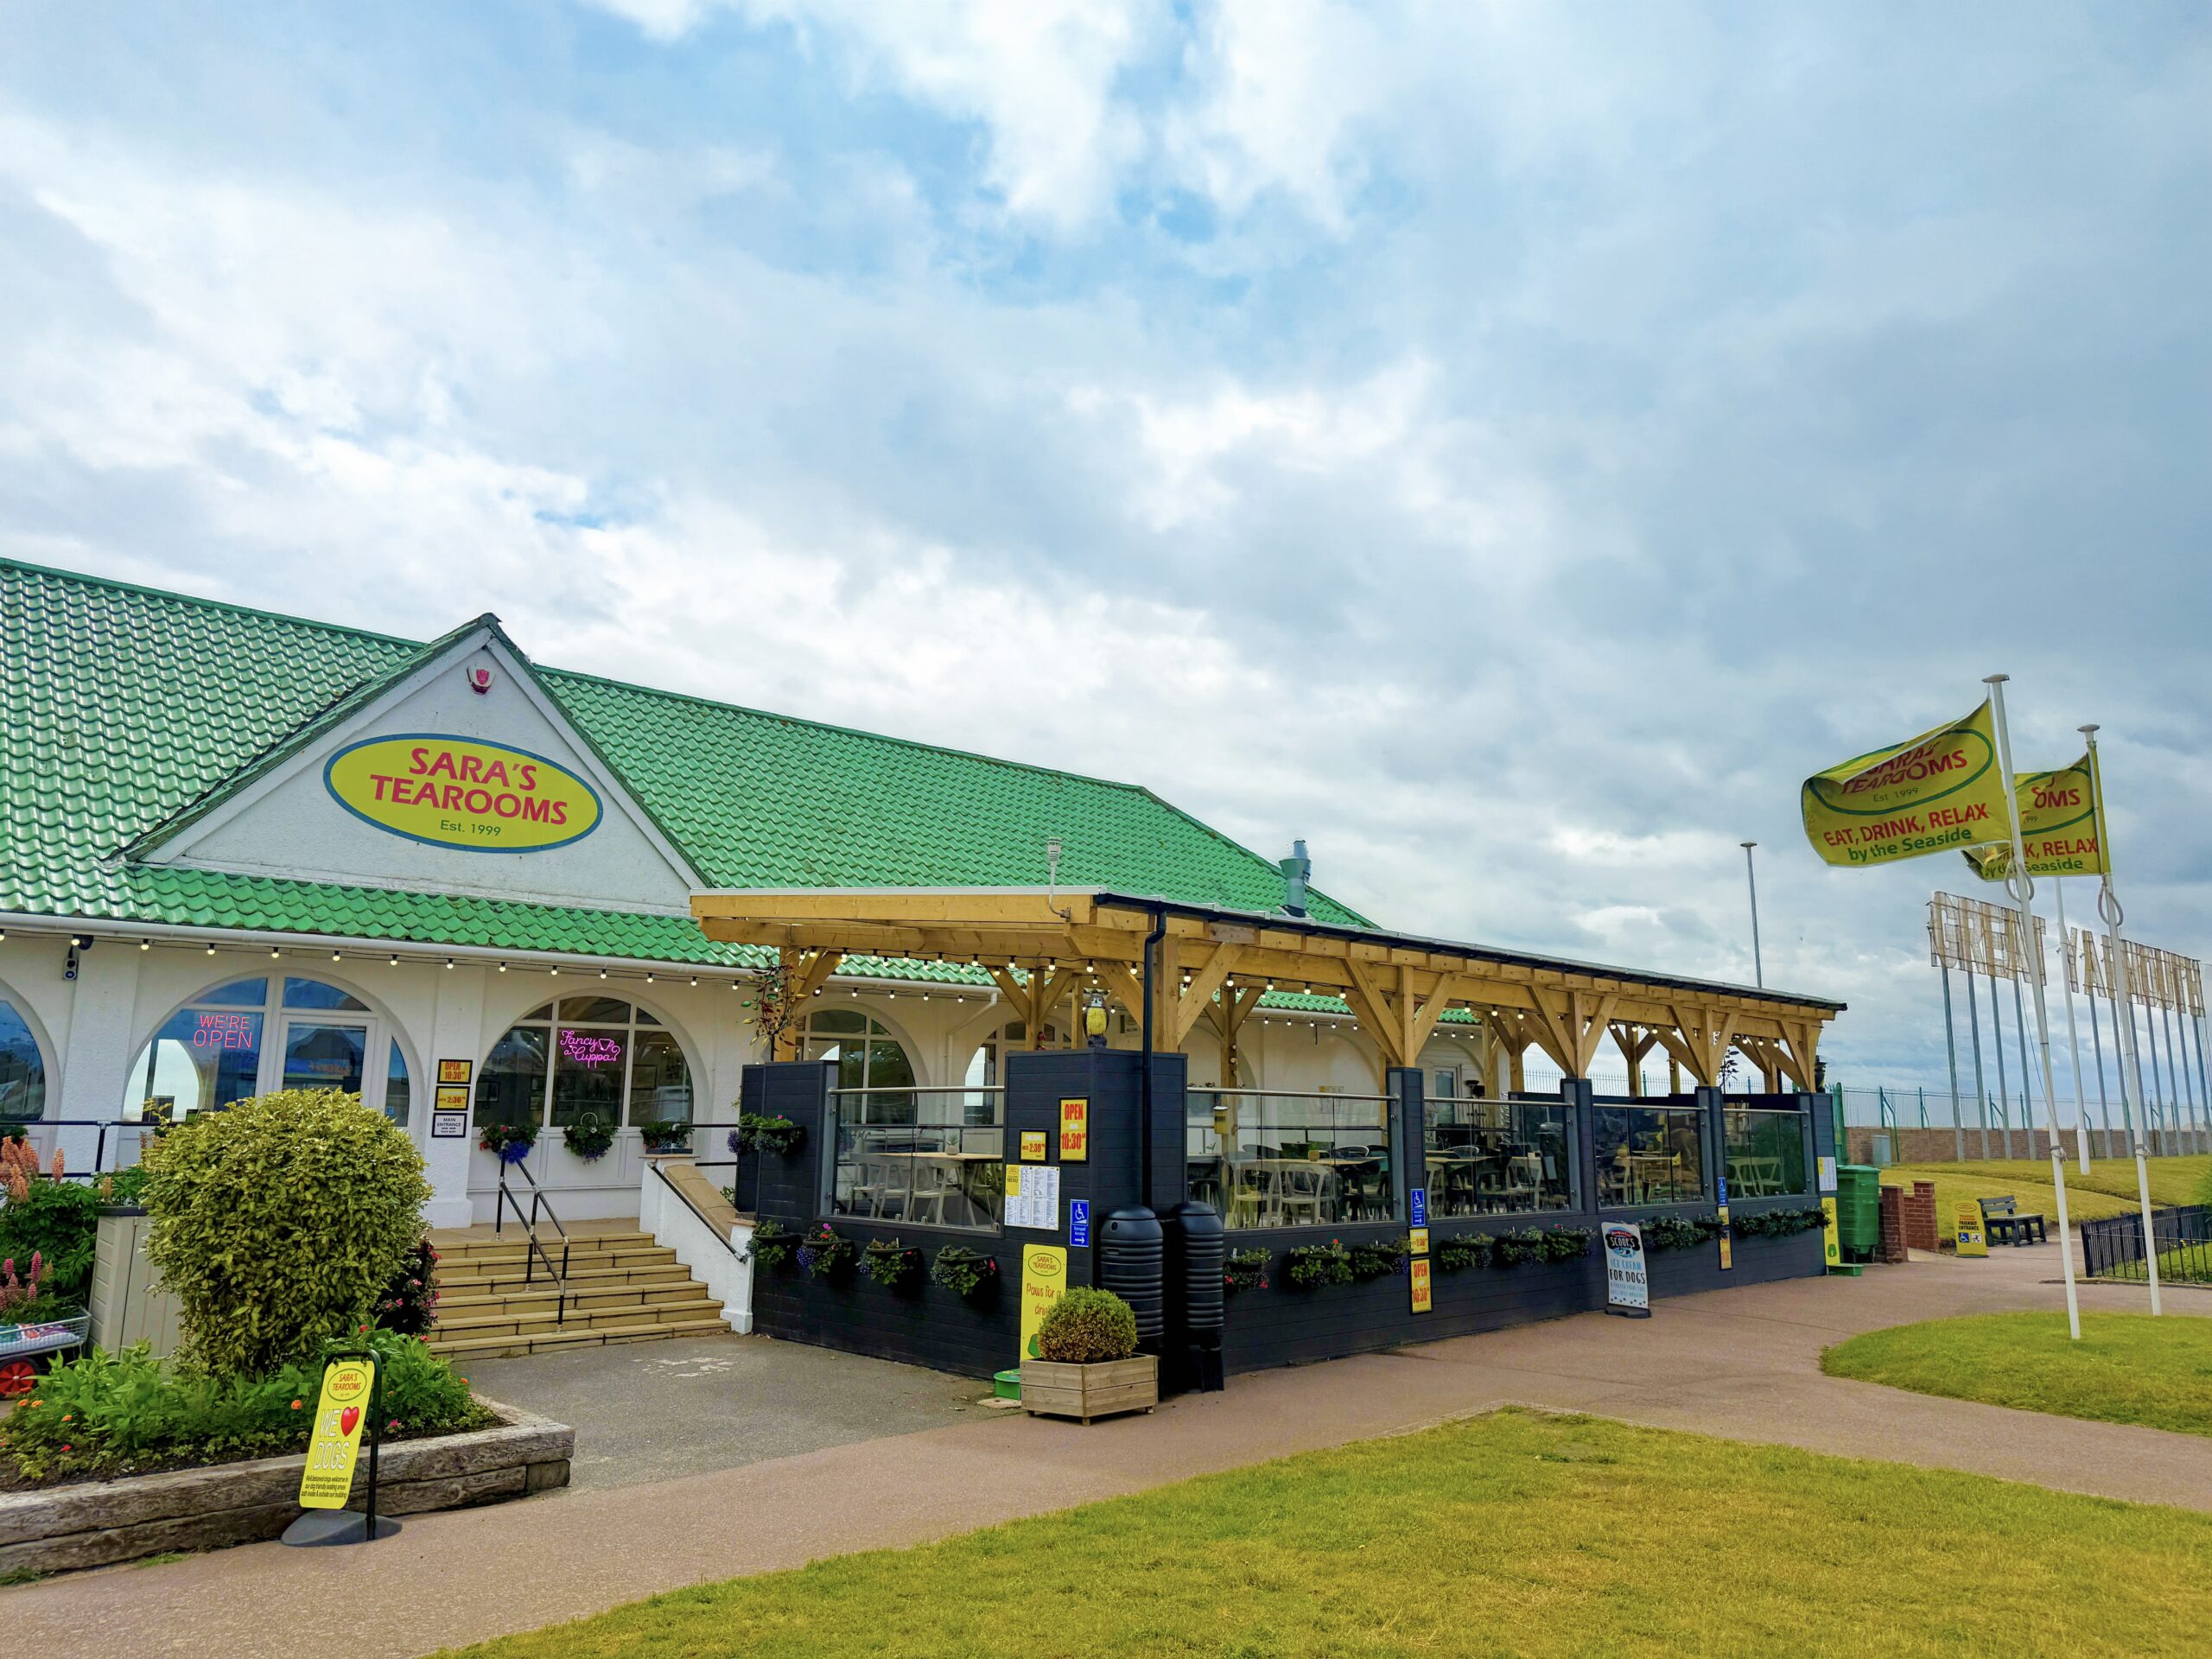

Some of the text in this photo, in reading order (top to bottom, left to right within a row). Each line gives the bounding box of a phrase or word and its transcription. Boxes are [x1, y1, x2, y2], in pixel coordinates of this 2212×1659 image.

[409, 747, 537, 791] SARA'S
[370, 774, 568, 825] TEAROOMS
[1895, 787, 1919, 798] 1999
[441, 819, 502, 836] Est. 1999
[1823, 802, 1990, 847] EAT, DRINK, RELAX
[1848, 827, 1973, 862] by the Seaside
[2042, 837, 2098, 857] RELAX
[200, 1014, 250, 1030] WE'RE
[194, 1029, 253, 1049] OPEN
[560, 1030, 599, 1052] Fancy
[444, 1062, 461, 1071] OPEN
[1065, 1103, 1084, 1121] OPEN
[1032, 1262, 1057, 1271] TEAROOMS
[1037, 1255, 1053, 1264] SARA'S
[1413, 1262, 1427, 1278] OPEN
[1609, 1268, 1646, 1284] FOR DOGS
[1026, 1282, 1044, 1298] Paws
[1045, 1285, 1055, 1299] for
[339, 1372, 359, 1382] SARA'S
[332, 1382, 362, 1391] TEAROOMS
[319, 1408, 341, 1438] WE
[314, 1440, 350, 1471] DOGS
